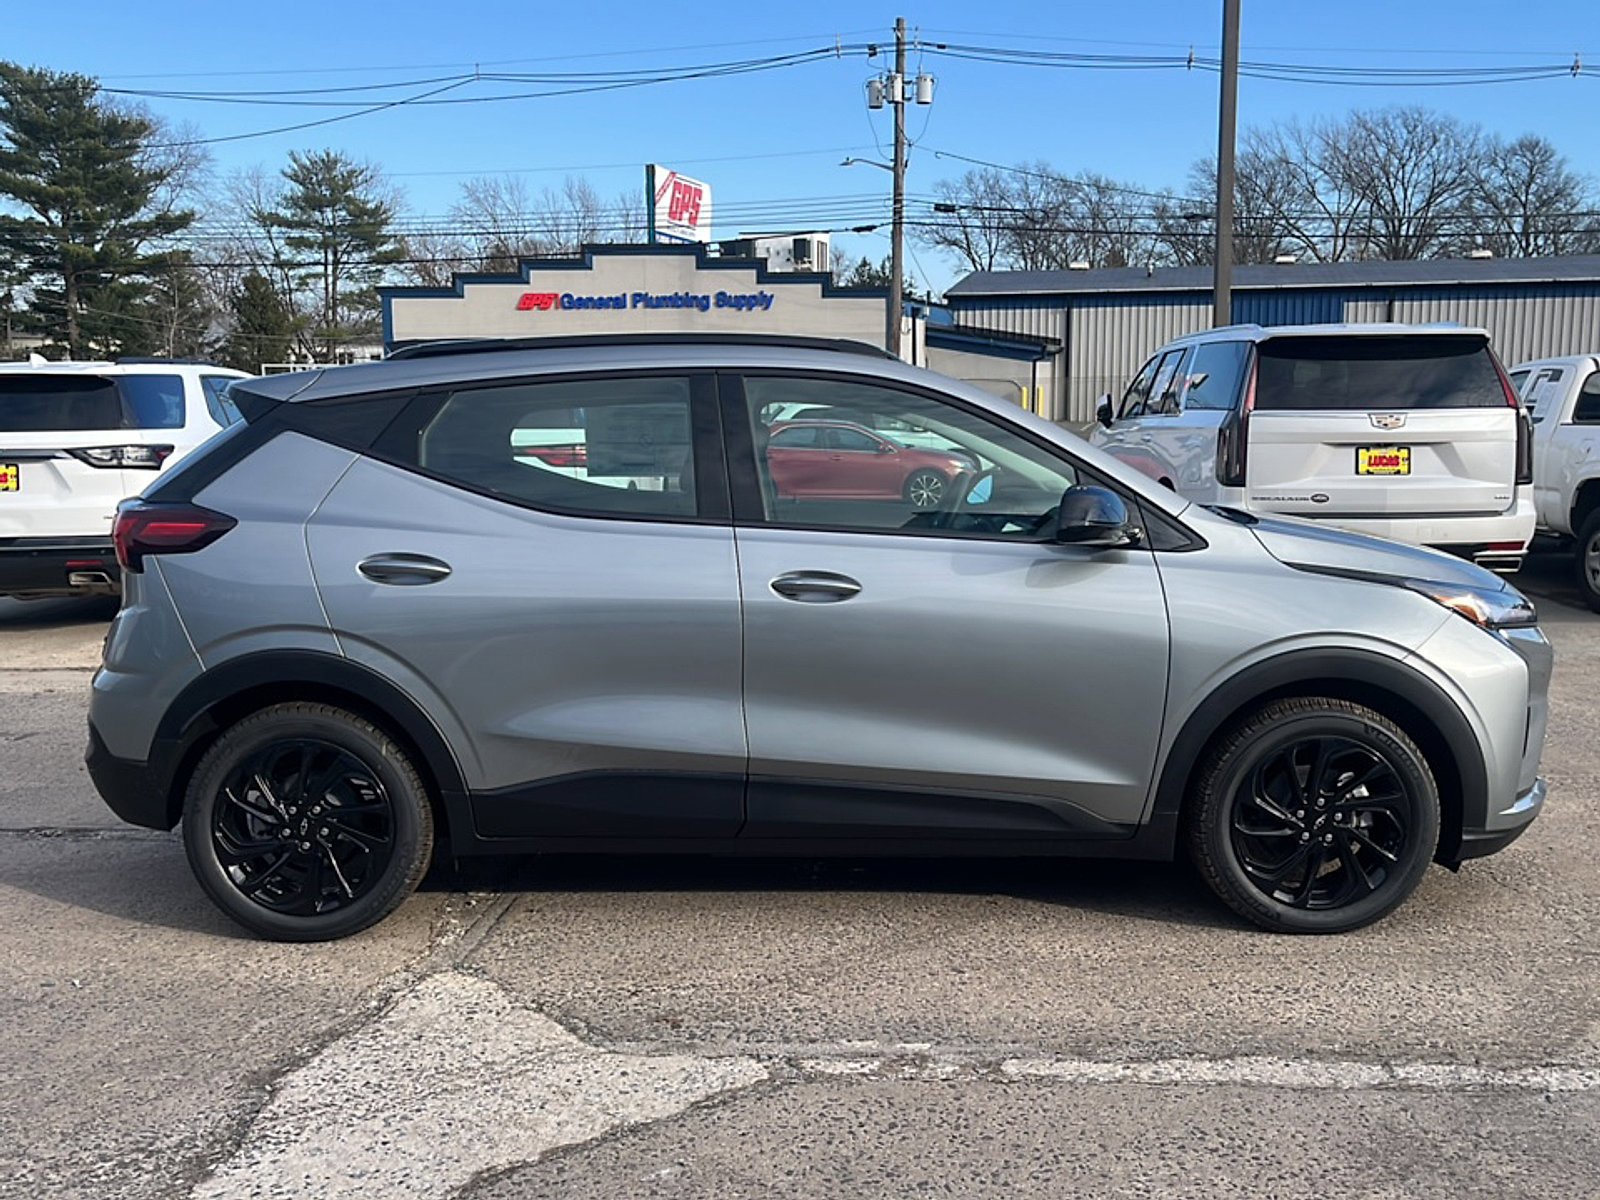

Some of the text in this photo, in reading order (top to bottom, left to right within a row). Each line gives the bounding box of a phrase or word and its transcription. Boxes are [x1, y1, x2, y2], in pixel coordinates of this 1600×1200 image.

[669, 181, 702, 225] GPS
[561, 293, 626, 310] General
[631, 292, 710, 312] Plumbing
[714, 291, 774, 311] Supply
[1367, 455, 1400, 467] LUCAS
